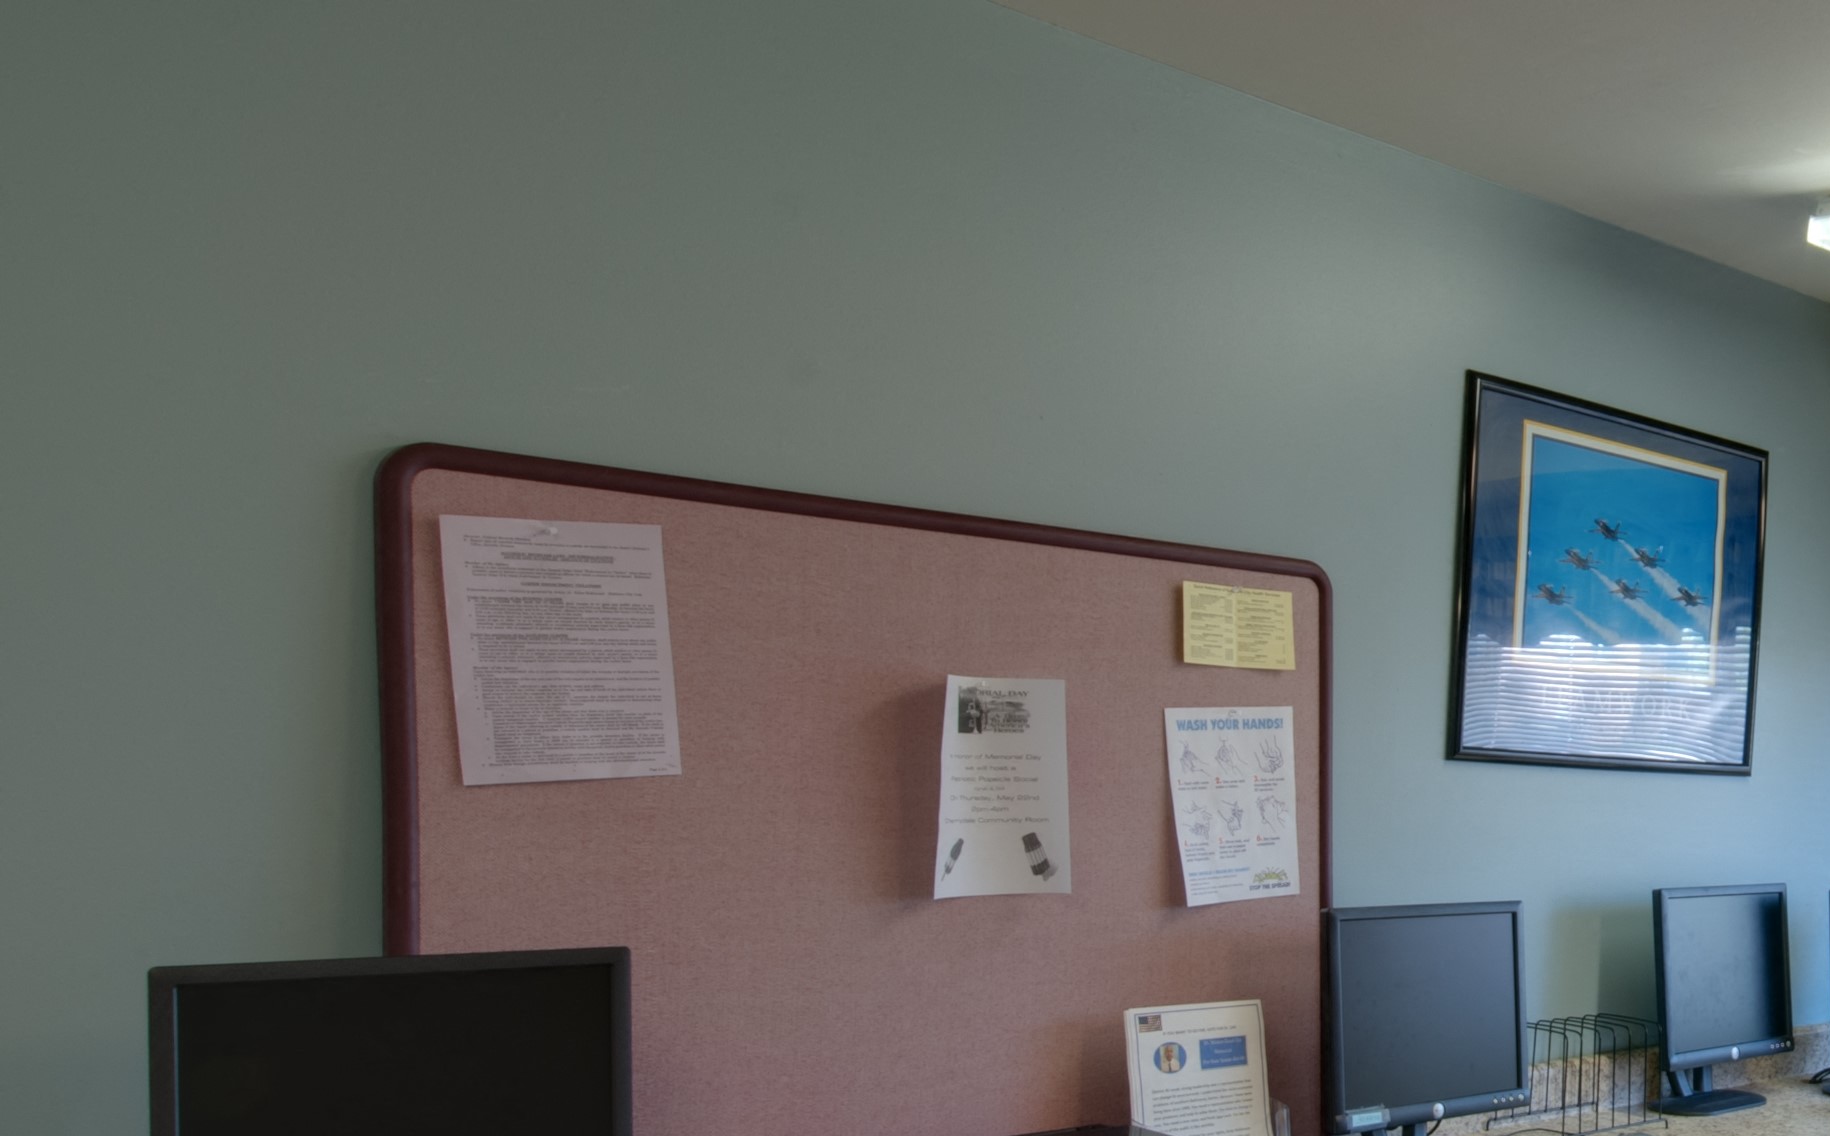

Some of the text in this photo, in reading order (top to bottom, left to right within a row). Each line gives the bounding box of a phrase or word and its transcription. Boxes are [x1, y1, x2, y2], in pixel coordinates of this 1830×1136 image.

[1540, 685, 1690, 720] TEAMWORK
[1176, 717, 1284, 731] WASH YOUR HANDS!
[1025, 753, 1042, 761] Day
[996, 794, 1015, 802] May
